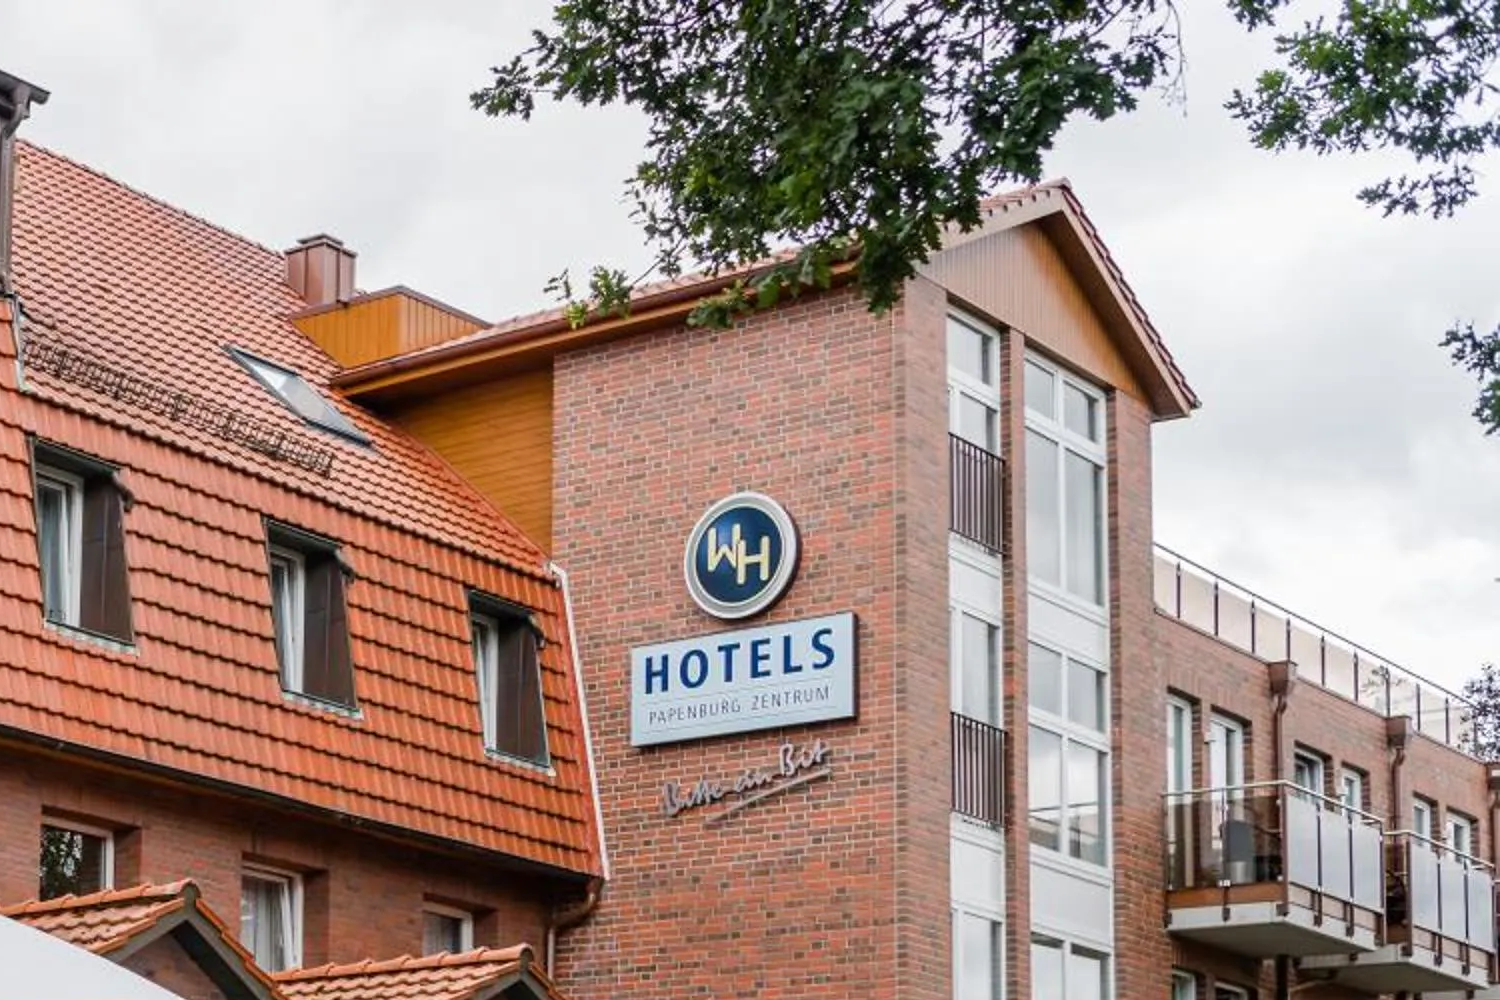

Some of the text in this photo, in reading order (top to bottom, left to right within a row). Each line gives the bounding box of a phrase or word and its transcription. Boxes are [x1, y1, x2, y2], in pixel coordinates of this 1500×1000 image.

[707, 524, 769, 584] WH
[645, 628, 835, 694] HOTELS
[649, 685, 830, 724] PAPENBURG ZENTRUM
